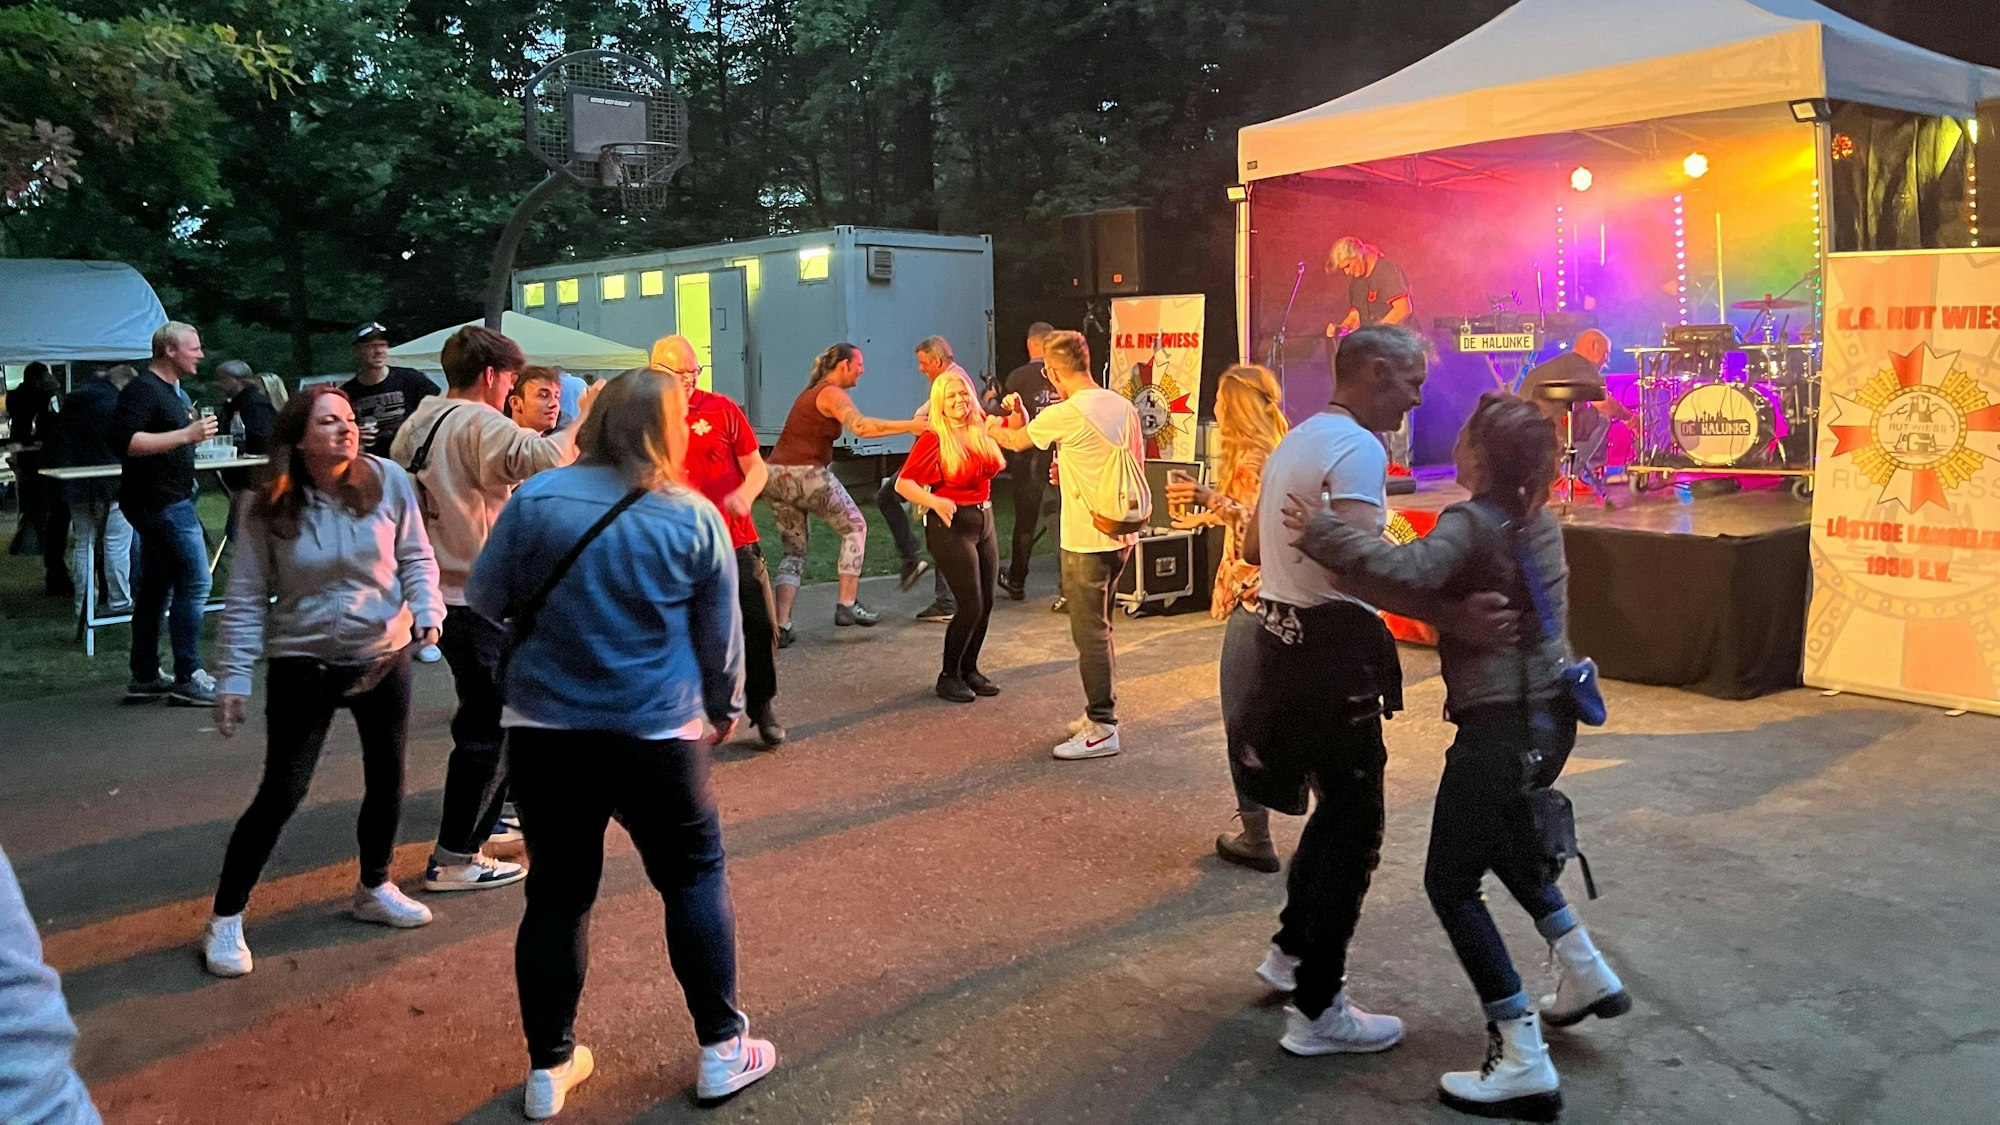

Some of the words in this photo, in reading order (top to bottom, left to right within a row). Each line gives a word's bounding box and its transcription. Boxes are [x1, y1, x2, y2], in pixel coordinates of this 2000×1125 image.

[1887, 305, 1937, 330] RUT
[1161, 332, 1199, 349] WIESS
[1463, 337, 1477, 349] DE
[1482, 336, 1531, 349] HALUNKE
[1682, 423, 1696, 435] DE
[1701, 422, 1750, 435] HALUNKE
